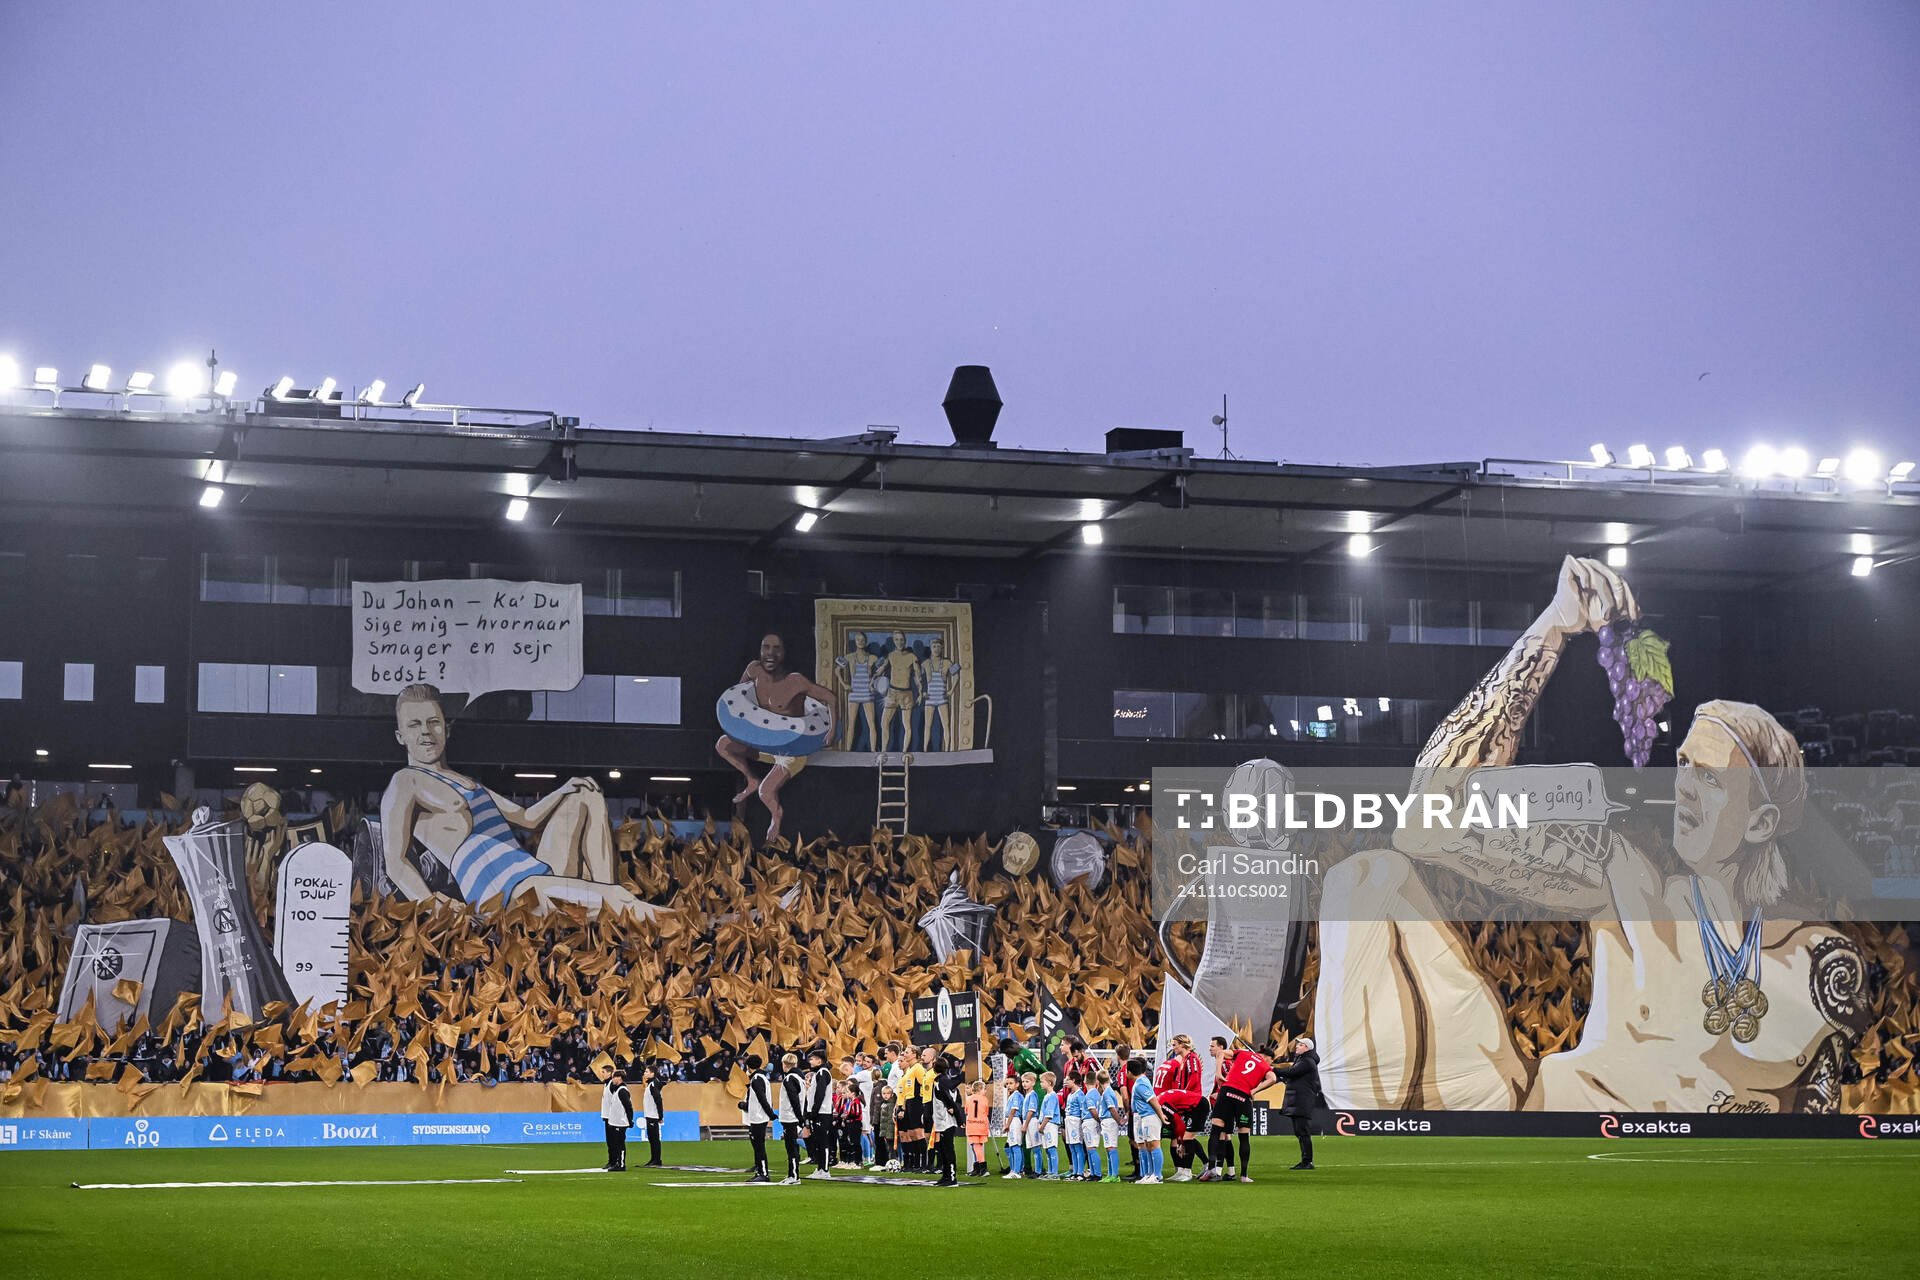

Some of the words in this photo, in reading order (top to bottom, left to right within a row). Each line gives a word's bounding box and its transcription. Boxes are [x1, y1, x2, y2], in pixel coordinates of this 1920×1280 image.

[362, 591, 385, 609] Du
[393, 590, 453, 610] Johan
[534, 593, 559, 609] Du
[412, 616, 447, 637] mig
[477, 615, 570, 631] hvornaar
[470, 642, 495, 655] en
[513, 640, 552, 663] sejr
[372, 664, 427, 682] bedst
[1545, 779, 1592, 811] gång!
[294, 878, 343, 889] POKAL-
[300, 889, 336, 900] DJUP
[291, 910, 317, 921] 100
[295, 962, 313, 973] 99
[1241, 1060, 1256, 1075] 9
[973, 1100, 979, 1118] 1
[322, 1122, 377, 1139] Boozt
[412, 1125, 481, 1134] SYDSVENSKAN
[535, 1122, 582, 1131] exakta
[1358, 1114, 1431, 1131] exakta
[1621, 1116, 1691, 1133] exakta
[22, 1130, 36, 1139] LF
[38, 1128, 72, 1140] Skåne
[235, 1127, 285, 1138] ELEDA
